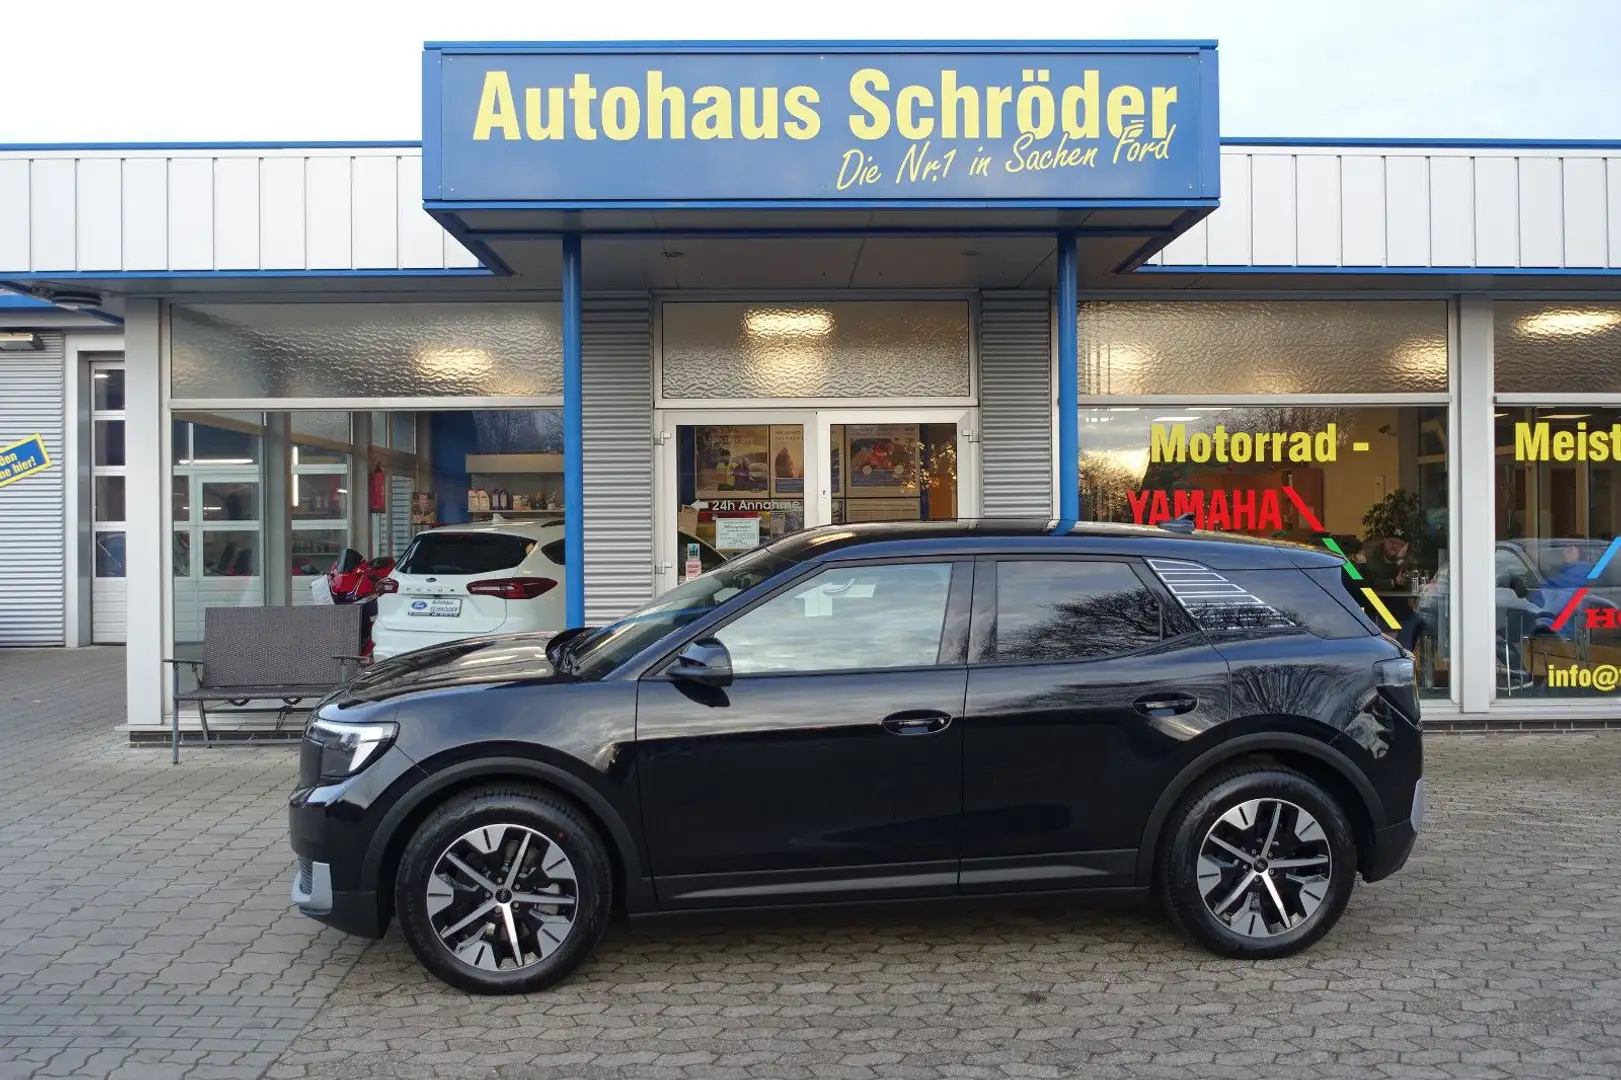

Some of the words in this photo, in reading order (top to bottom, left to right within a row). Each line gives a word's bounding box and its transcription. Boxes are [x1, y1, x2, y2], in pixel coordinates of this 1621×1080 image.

[472, 70, 821, 141] Autohaus
[848, 68, 1178, 140] Schröder
[836, 148, 882, 190] Die
[895, 141, 956, 184] Nr.1
[969, 146, 989, 177] in
[1005, 130, 1098, 172] Sachen
[1112, 119, 1177, 163] Ford
[1150, 423, 1337, 462] Motorrad
[12, 456, 37, 473] hier!
[712, 500, 736, 511] 24h
[738, 500, 801, 511] Annahme
[1127, 489, 1283, 530] YAMAHA
